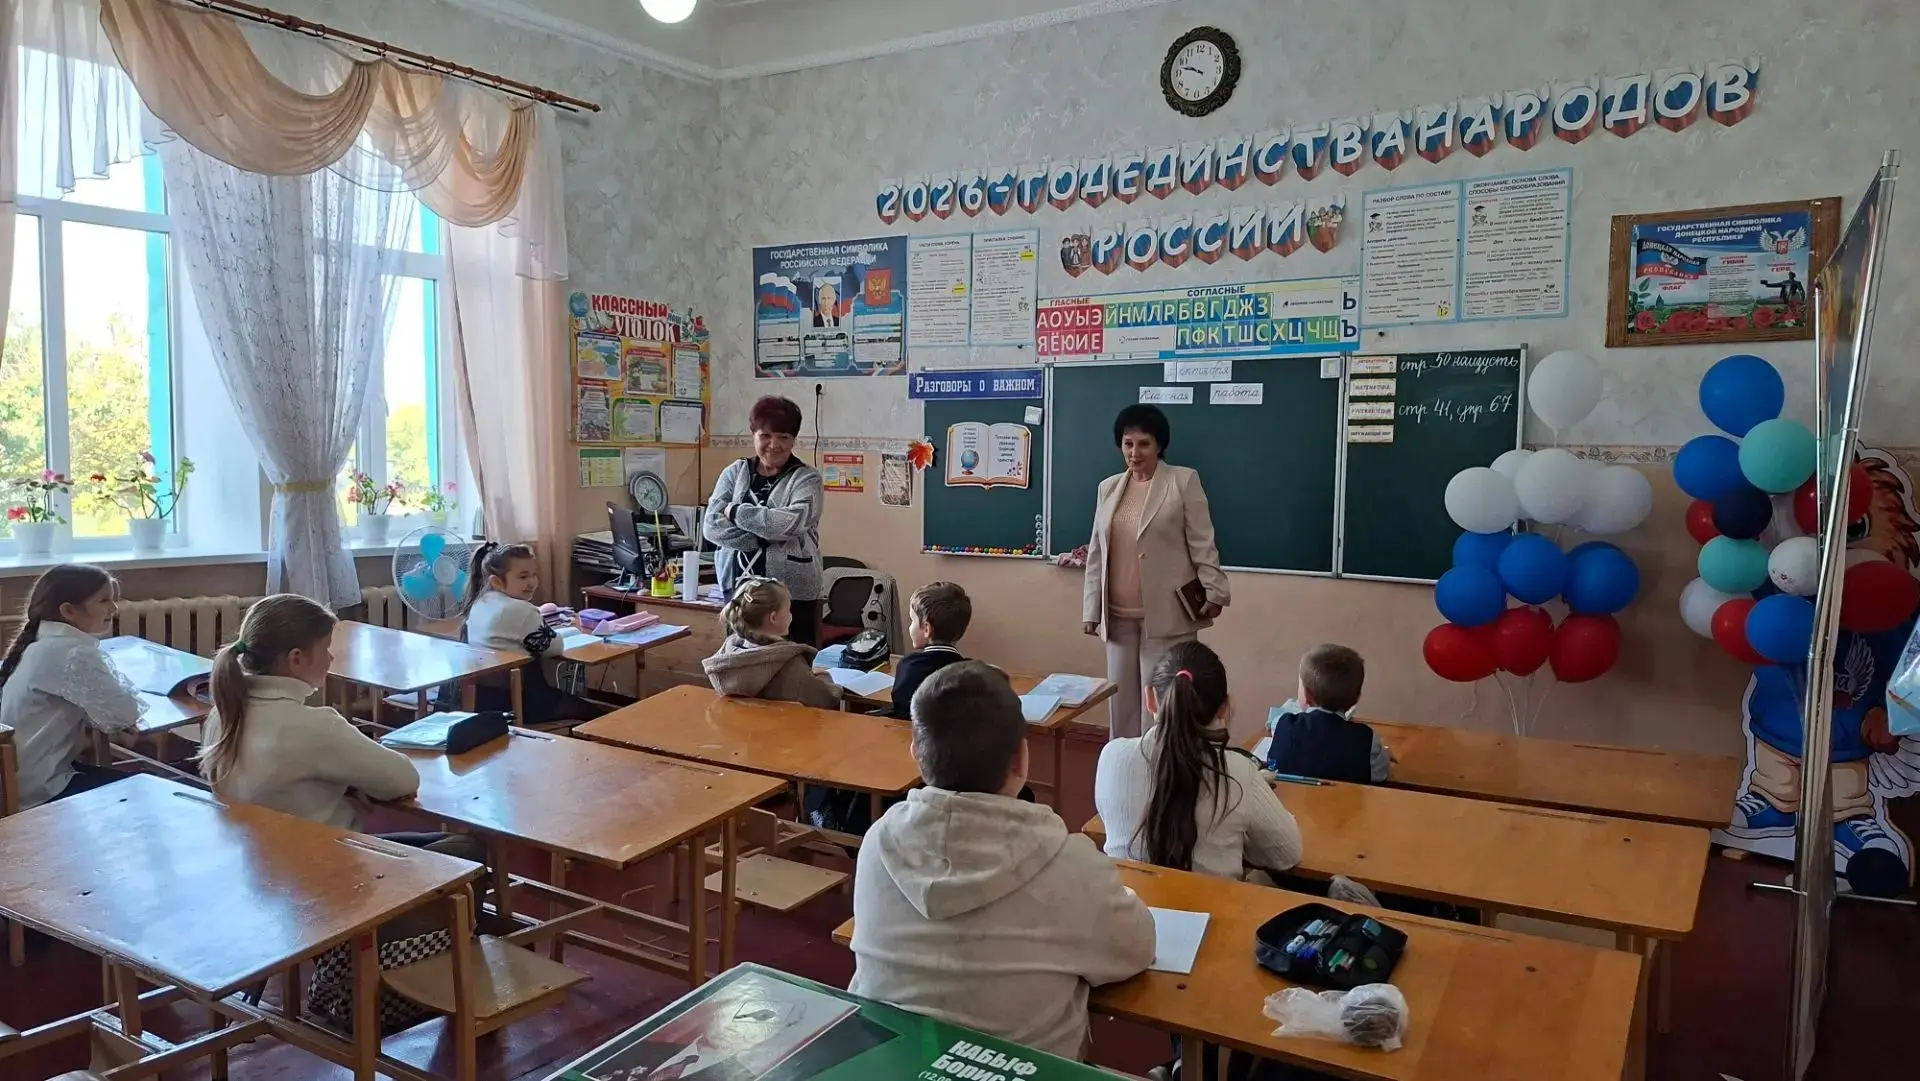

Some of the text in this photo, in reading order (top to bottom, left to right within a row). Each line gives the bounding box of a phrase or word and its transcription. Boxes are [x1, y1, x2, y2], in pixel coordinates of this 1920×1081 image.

[1186, 48, 1193, 57] 11
[1196, 44, 1205, 53] 12
[1208, 46, 1212, 55] 1
[1179, 57, 1188, 66] 10
[1214, 54, 1220, 62] 2
[1175, 69, 1182, 77] 9
[1215, 65, 1221, 74] 3
[1177, 79, 1183, 88] 8
[1184, 87, 1190, 96] 7
[1193, 90, 1200, 98] 6
[1204, 86, 1210, 94] 5
[1499, 180, 1566, 192] СЛОВООБРАЗОВАНИЯ
[1657, 216, 1782, 232] ГОСУДАРСТВЕННАЯ СИМВОЛИКА
[1096, 203, 1302, 264] РОССИИ
[1674, 225, 1763, 239] ДОНЕЦКОЙ НАРОДНОЙ
[1692, 234, 1744, 244] РЕСПУБЛИКИ
[770, 242, 889, 260] ГОСУДАРСТВЕННАЯ СИМВОЛИКА
[780, 254, 877, 270] РОССИЙСКОЙ ФЕДЕРАЦИИ
[1187, 285, 1246, 297] СОГЛАСНЫЕ
[591, 294, 669, 318] КЛАССНЫЙ
[1050, 297, 1090, 306] ГЛАСНЫЕ
[614, 314, 676, 343] УГОЛОК
[1433, 352, 1452, 368] 50
[1213, 385, 1259, 400] работа
[1489, 393, 1513, 413] 67
[947, 1040, 1038, 1075] КАБЫФ
[931, 1054, 1006, 1081] Борис
